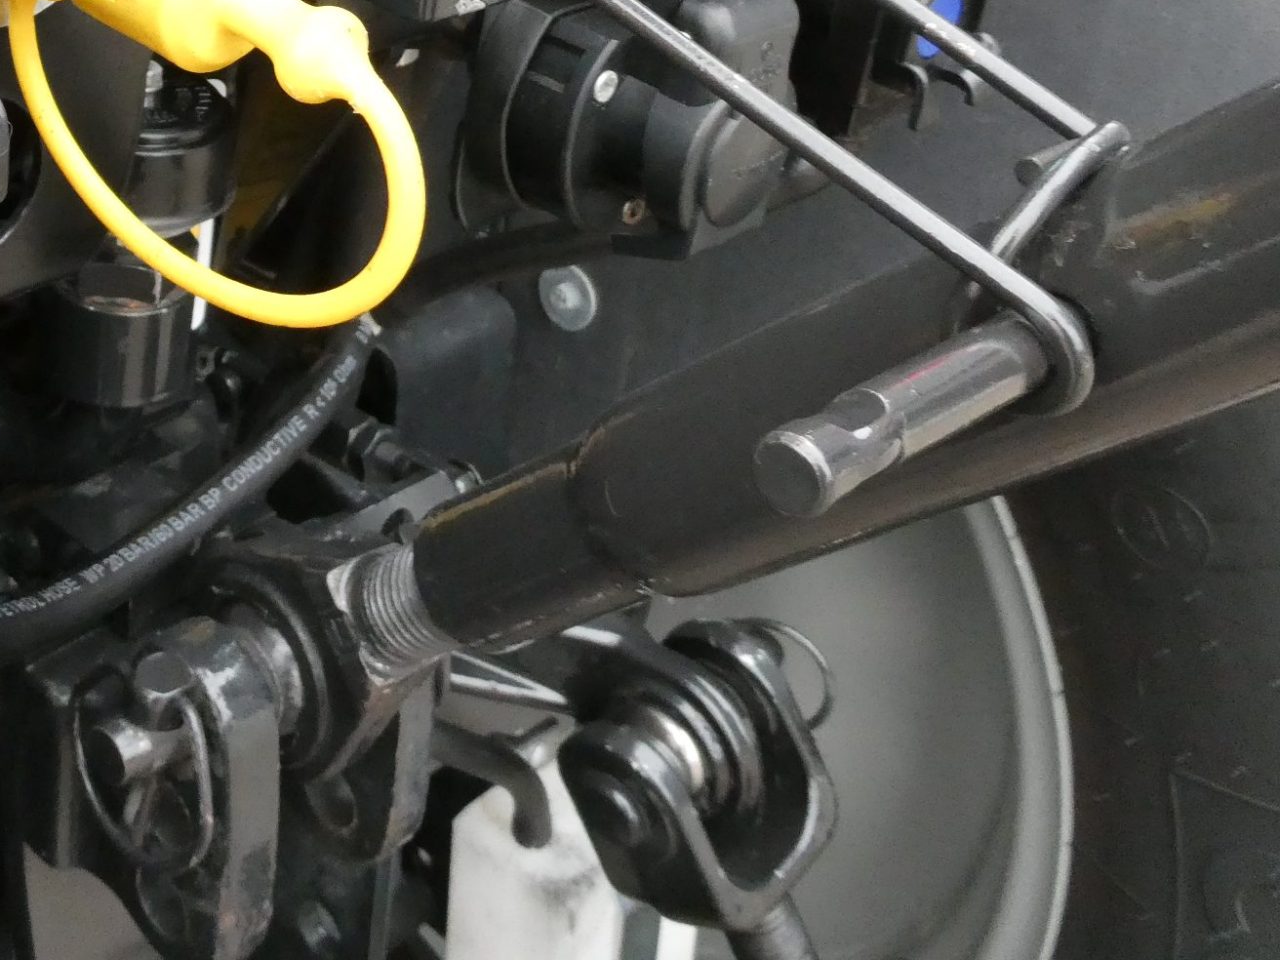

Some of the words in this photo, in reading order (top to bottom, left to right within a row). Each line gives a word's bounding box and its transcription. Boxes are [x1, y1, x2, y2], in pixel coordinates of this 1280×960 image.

[169, 501, 206, 532] BAR
[200, 487, 223, 511] BP
[222, 415, 308, 491] CONDUCTIVE
[302, 403, 320, 420] R
